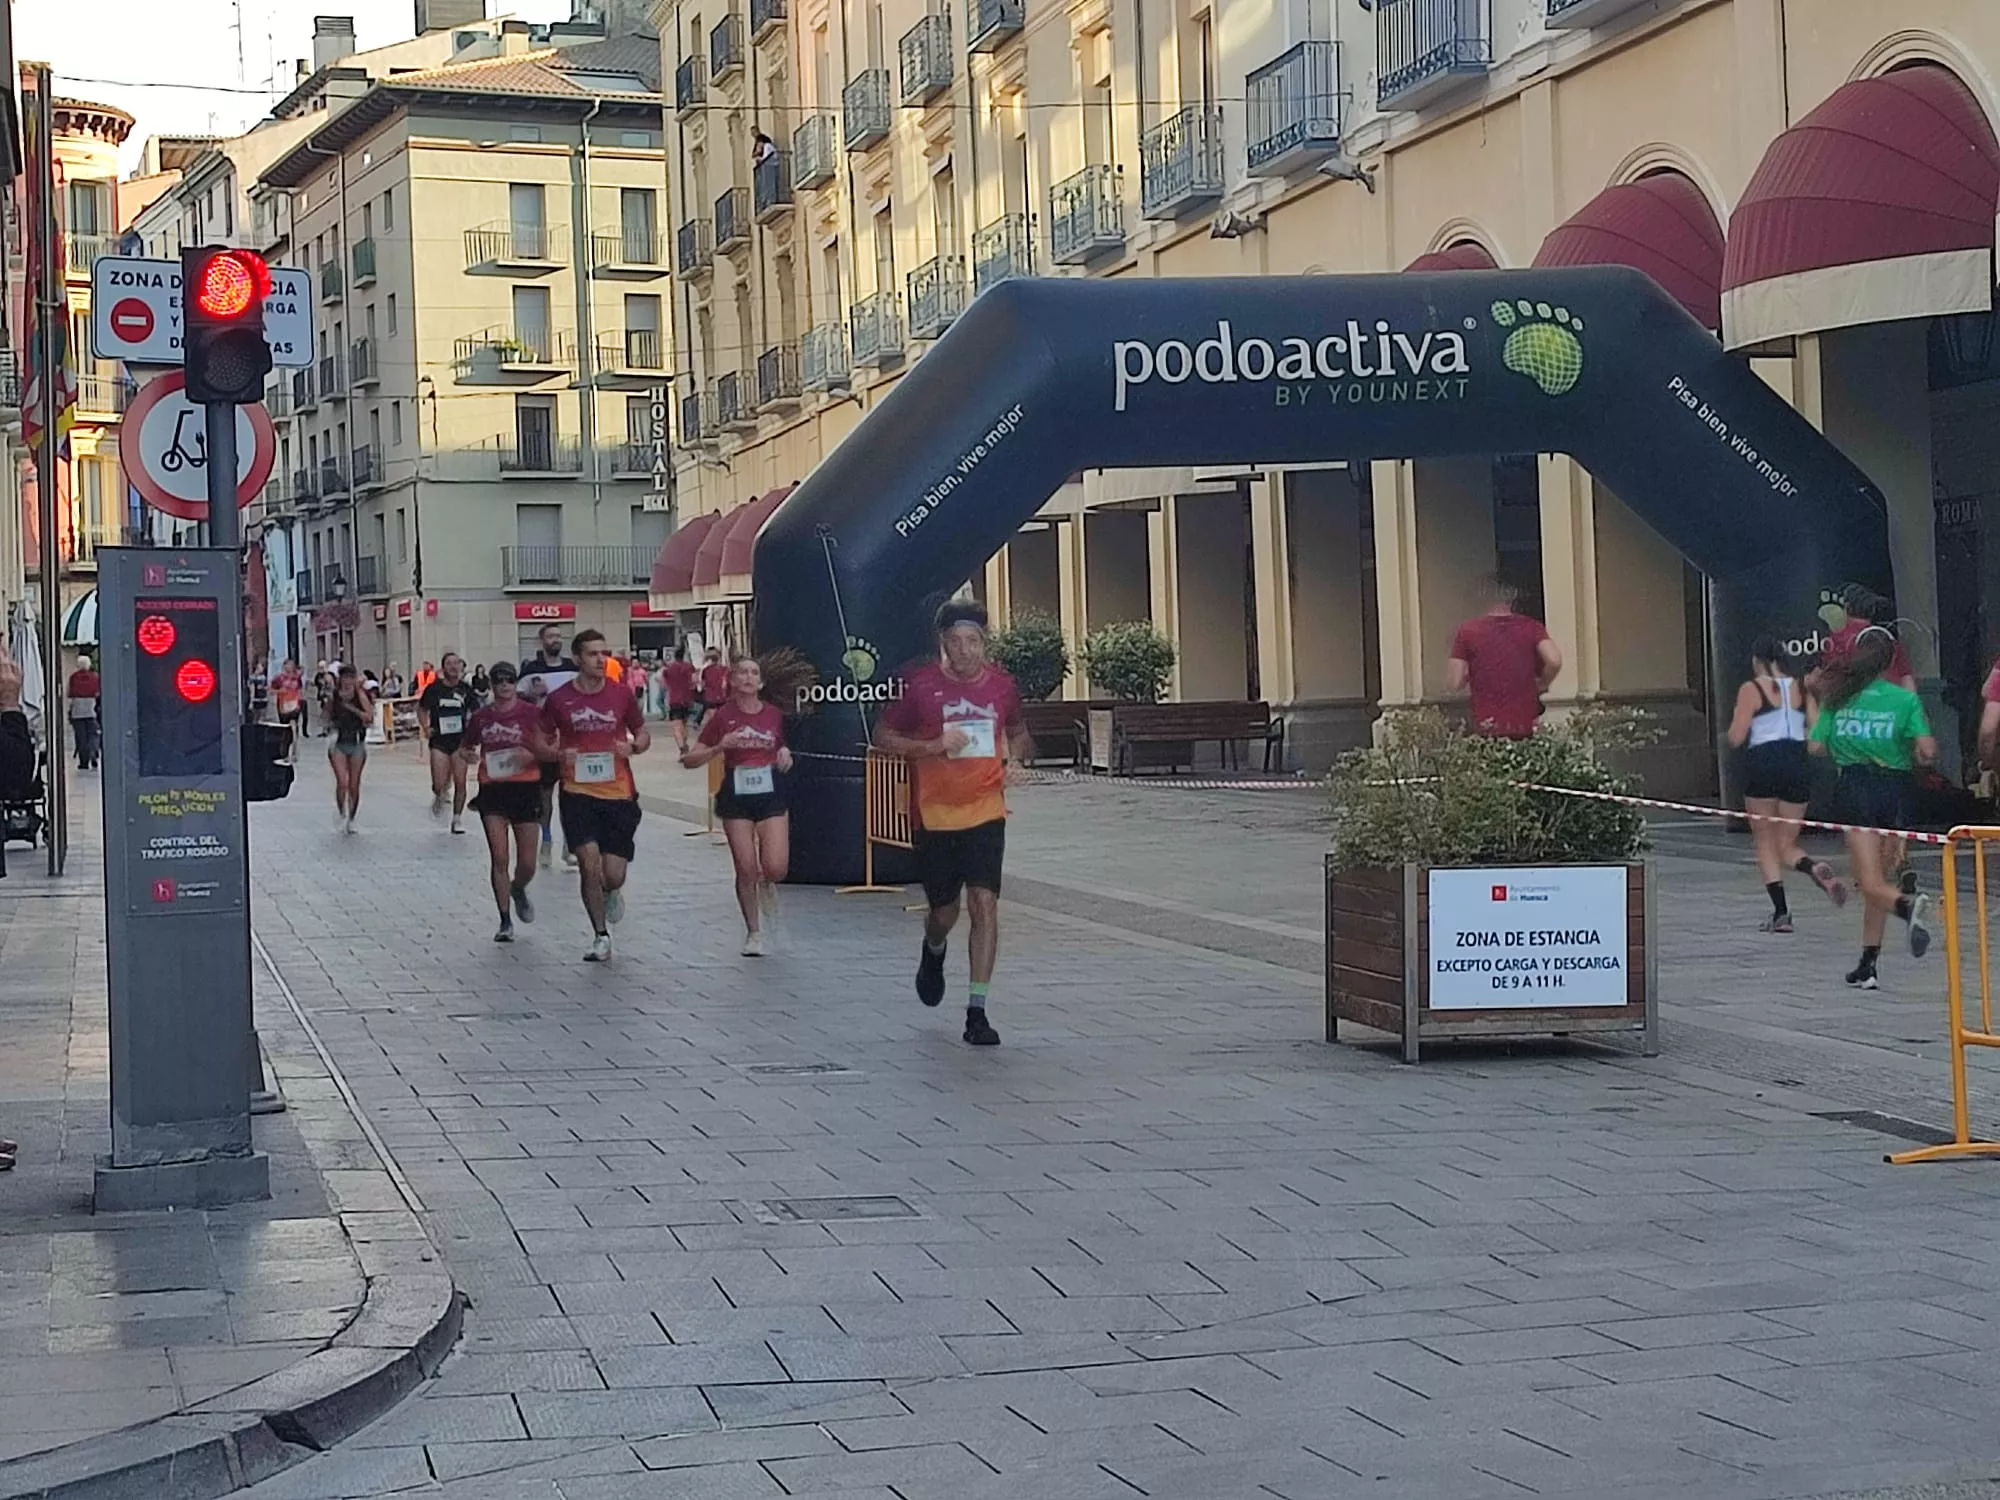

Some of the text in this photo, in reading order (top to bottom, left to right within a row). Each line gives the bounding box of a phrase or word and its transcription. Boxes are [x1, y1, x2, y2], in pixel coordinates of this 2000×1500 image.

[110, 270, 184, 289] ZONA D
[170, 315, 179, 328] Y
[1275, 378, 1470, 407] BY YOUNEXT
[651, 385, 668, 491] HOSTAL
[1667, 376, 1799, 497] Pisa bien, vive mejor
[895, 403, 1024, 537] Pisa bien, vive mejor
[795, 675, 909, 713] podoacti
[149, 835, 220, 849] CONTROL DEL
[186, 846, 229, 857] RODADO
[1456, 929, 1601, 947] ZONA DE ESTANCIA
[1436, 956, 1621, 973] EXCEPTO CARGA Y DESCARGA
[1492, 974, 1566, 989] DE 9 A 11 H.
